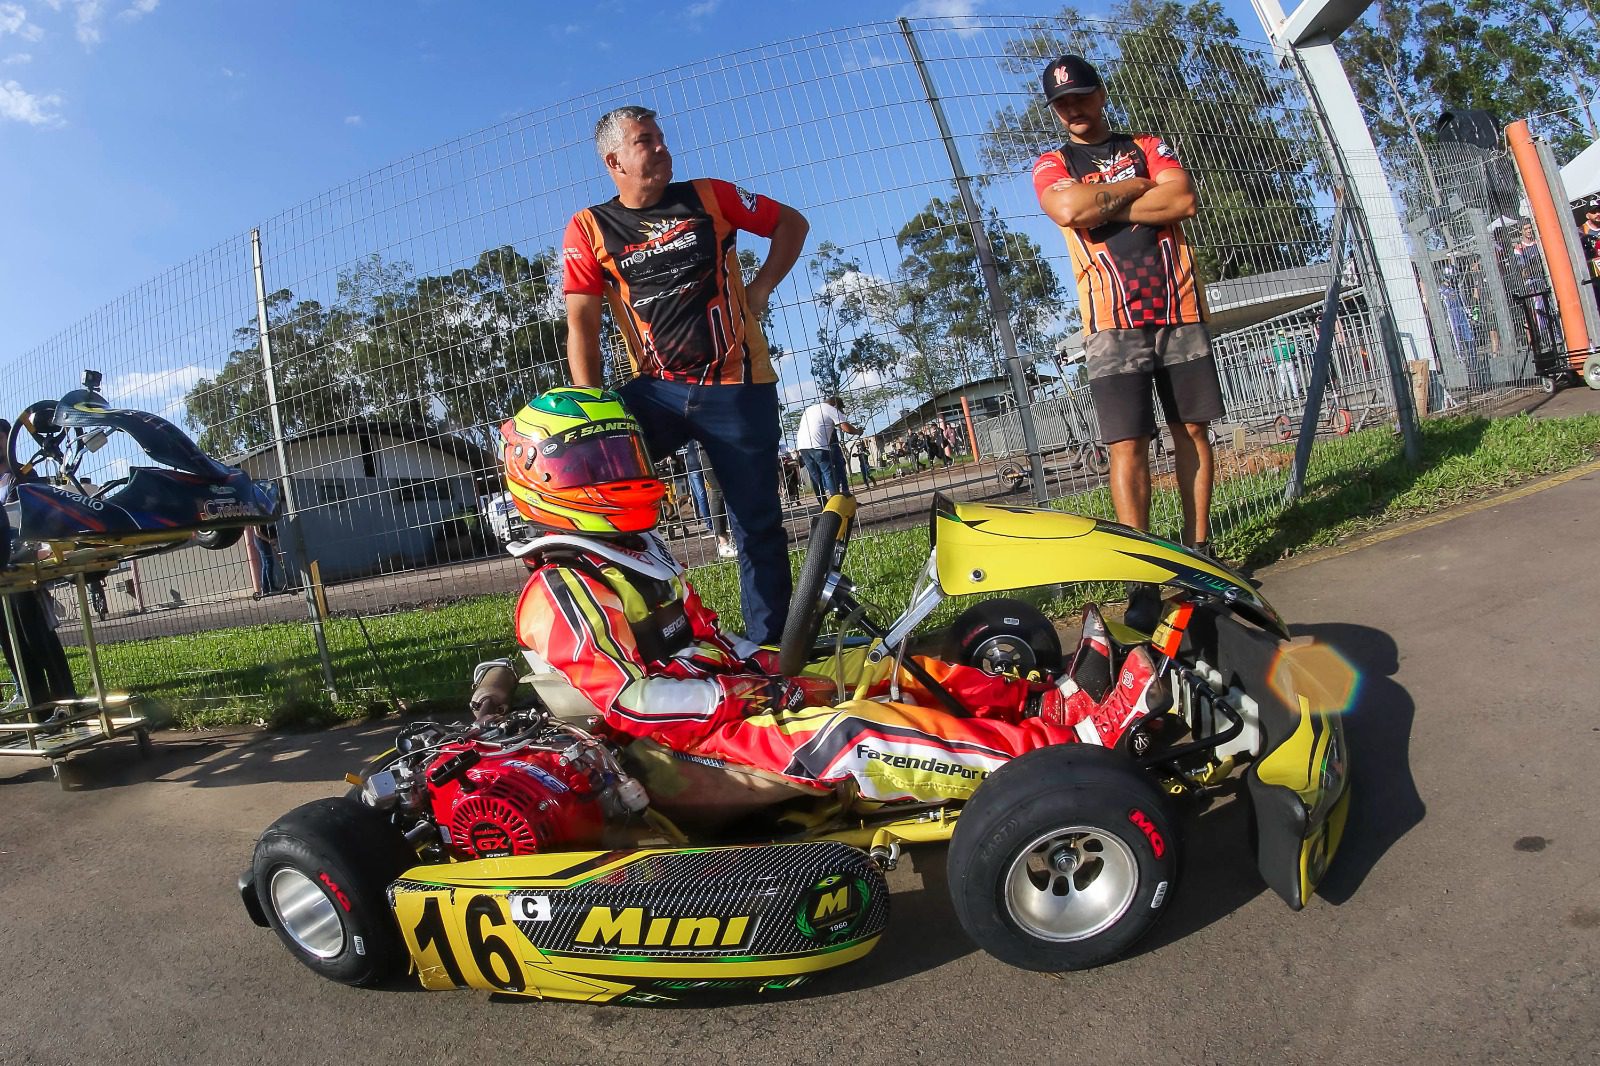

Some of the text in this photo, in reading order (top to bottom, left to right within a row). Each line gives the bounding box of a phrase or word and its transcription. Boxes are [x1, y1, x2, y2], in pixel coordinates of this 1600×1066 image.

[475, 836, 509, 851] GX
[1130, 809, 1166, 859] MG
[521, 897, 539, 919] C
[813, 885, 848, 920] M
[413, 893, 527, 992] 16
[574, 905, 750, 947] Mini
[829, 920, 848, 932] 1960
